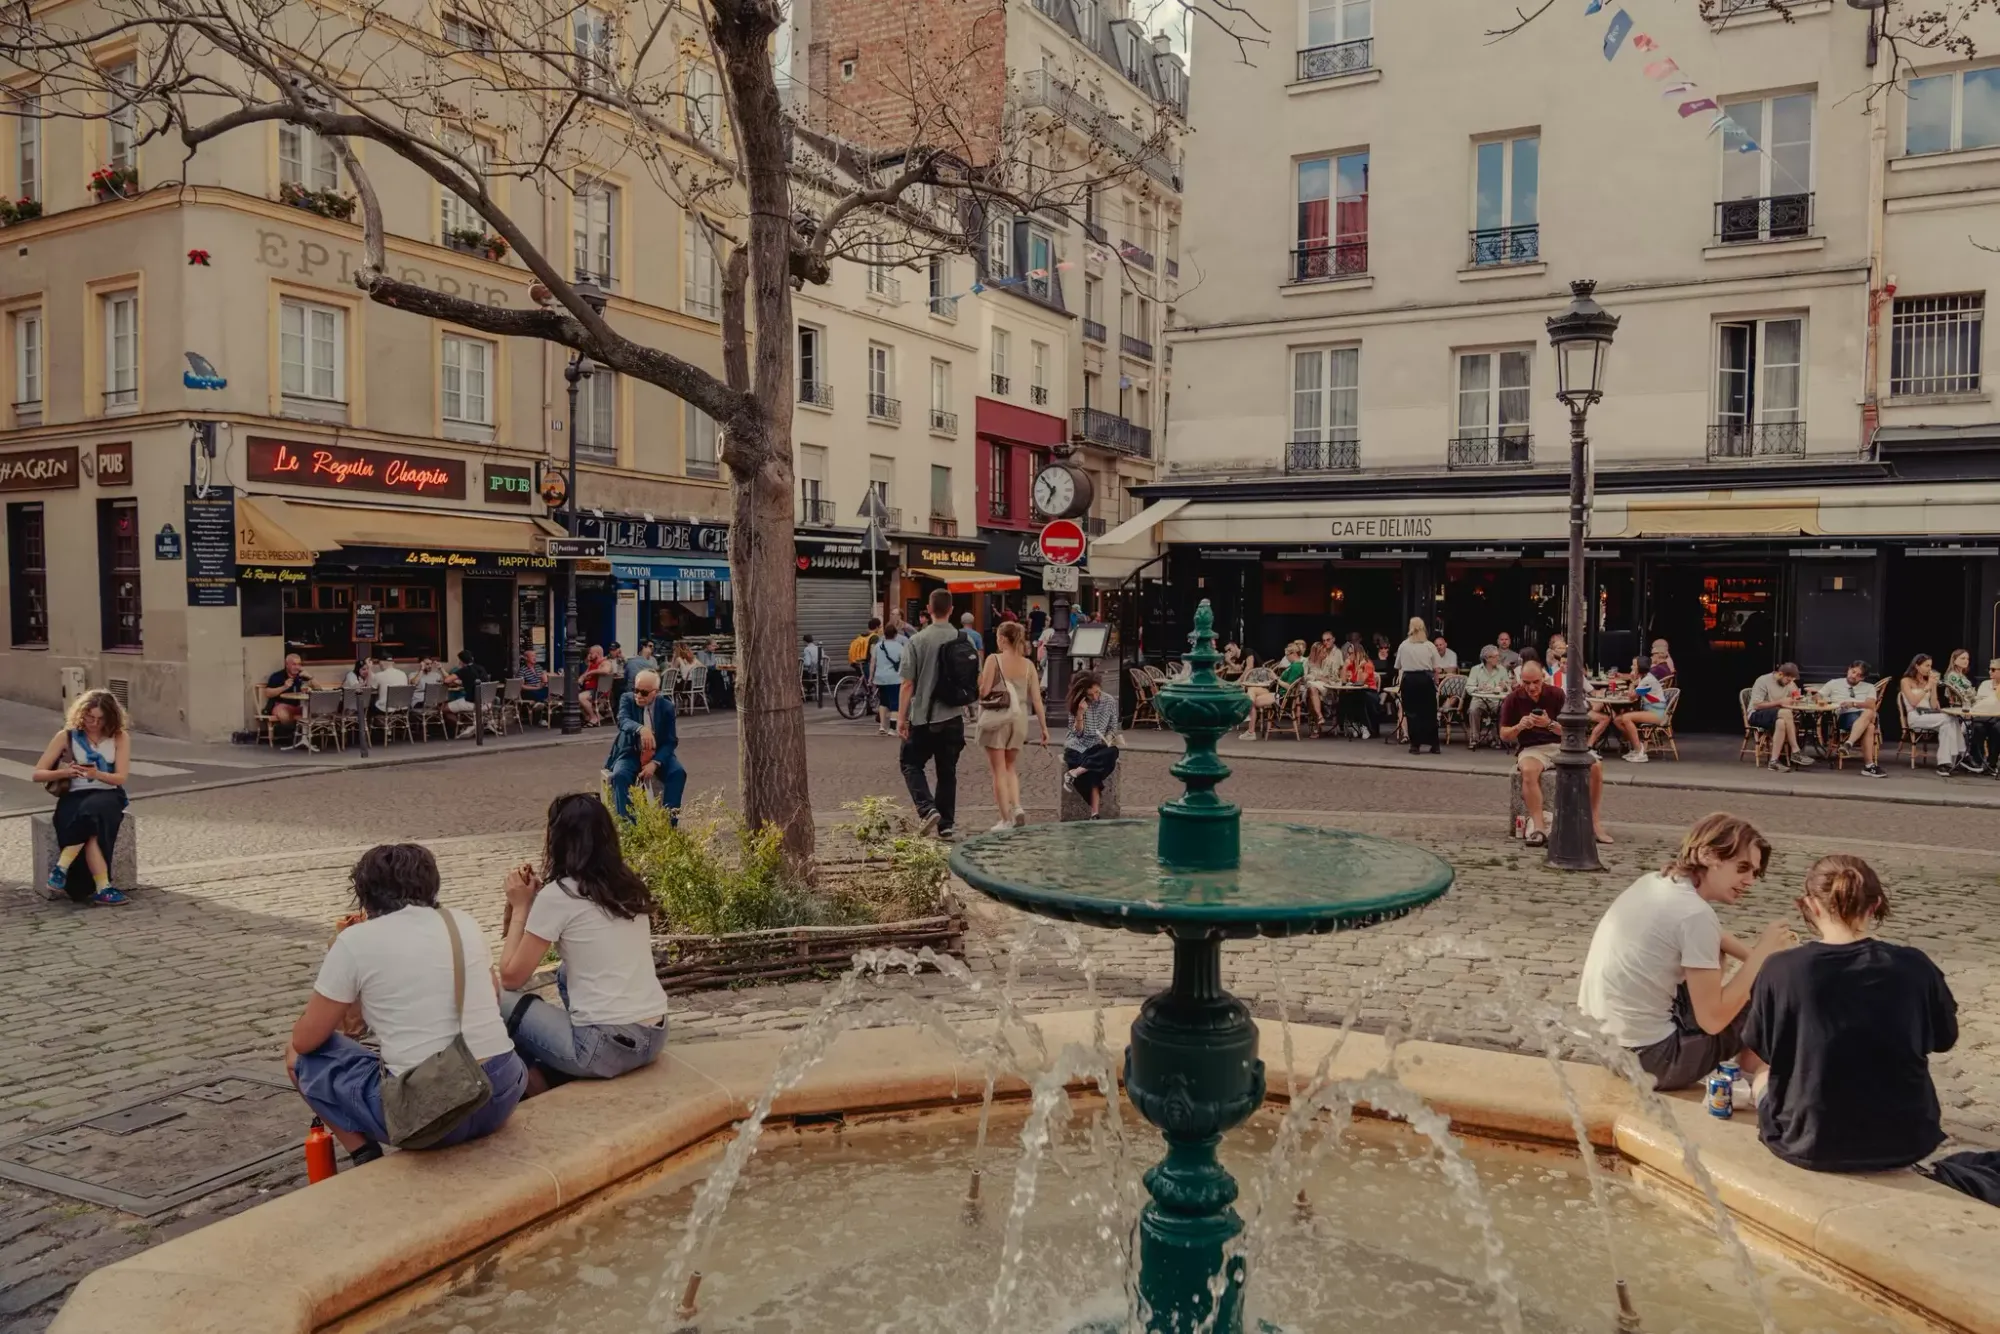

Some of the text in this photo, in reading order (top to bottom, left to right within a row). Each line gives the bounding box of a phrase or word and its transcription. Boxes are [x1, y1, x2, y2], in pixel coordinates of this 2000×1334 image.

[0, 458, 68, 482] HAGRIN
[99, 453, 124, 474] PUB
[274, 445, 448, 491] Le Requin Chagrin
[490, 476, 530, 493] PUB
[1332, 518, 1432, 537] CAFE DELMAS
[240, 529, 255, 545] 12
[658, 524, 692, 550] DE
[269, 549, 309, 560] PRESSION
[1018, 541, 1029, 556] Le
[406, 552, 476, 566] Le Requin Chagrin
[498, 556, 557, 568] HAPPY HOUR
[242, 568, 253, 578] Le
[679, 568, 715, 579] TRAITEUR
[1050, 567, 1073, 575] SAUF
